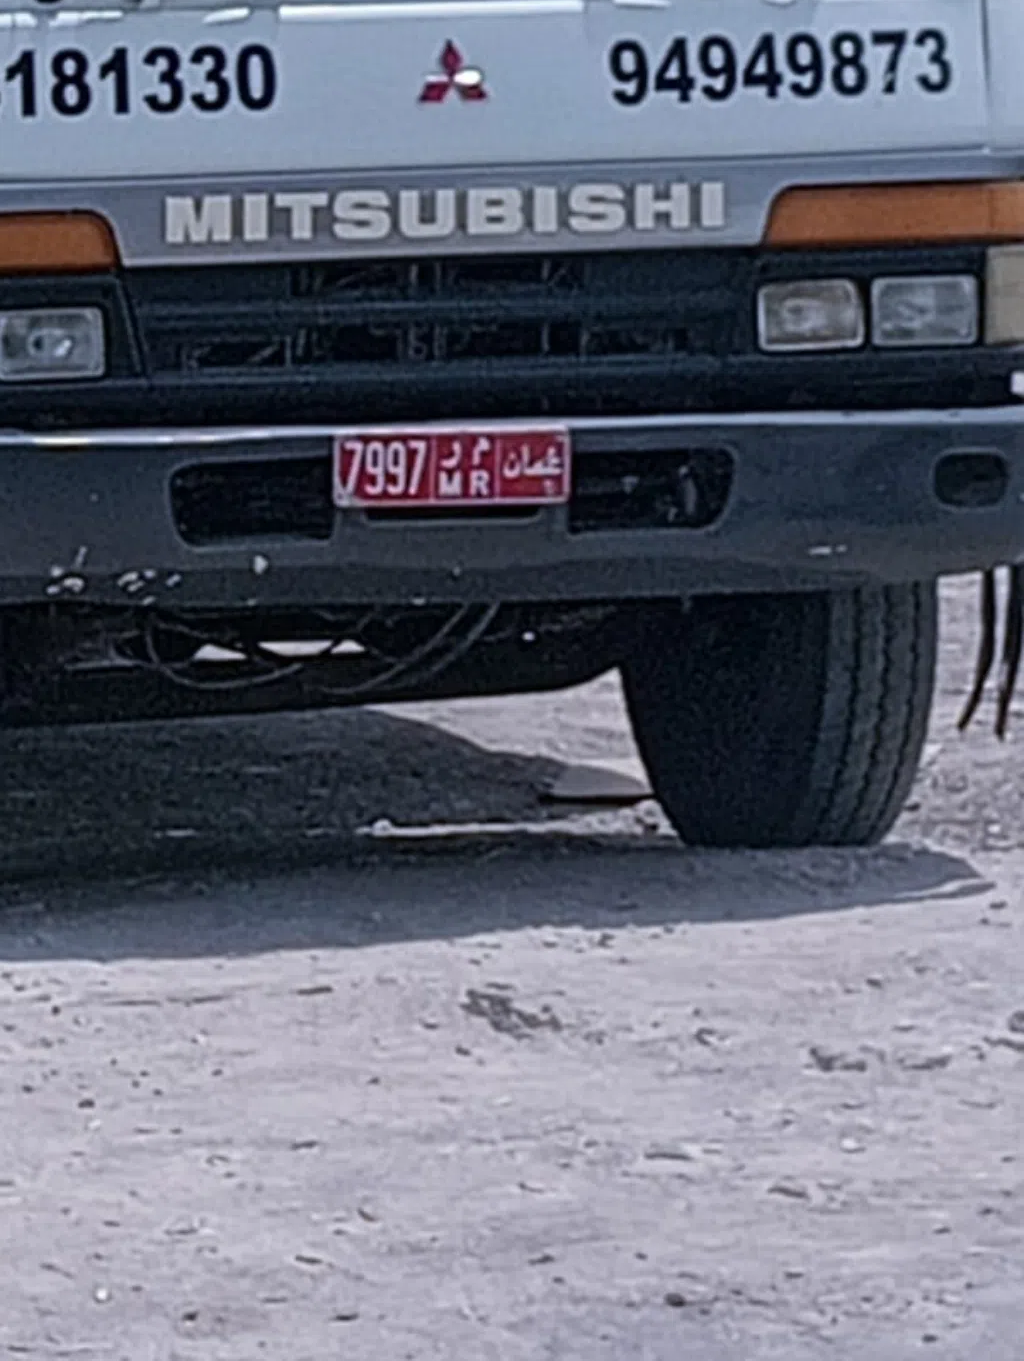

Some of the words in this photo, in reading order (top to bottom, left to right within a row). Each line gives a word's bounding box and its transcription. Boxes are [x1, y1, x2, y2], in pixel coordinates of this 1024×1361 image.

[608, 28, 954, 106] 94949873
[164, 181, 727, 245] MITSUBISHI
[342, 439, 428, 496] 7997
